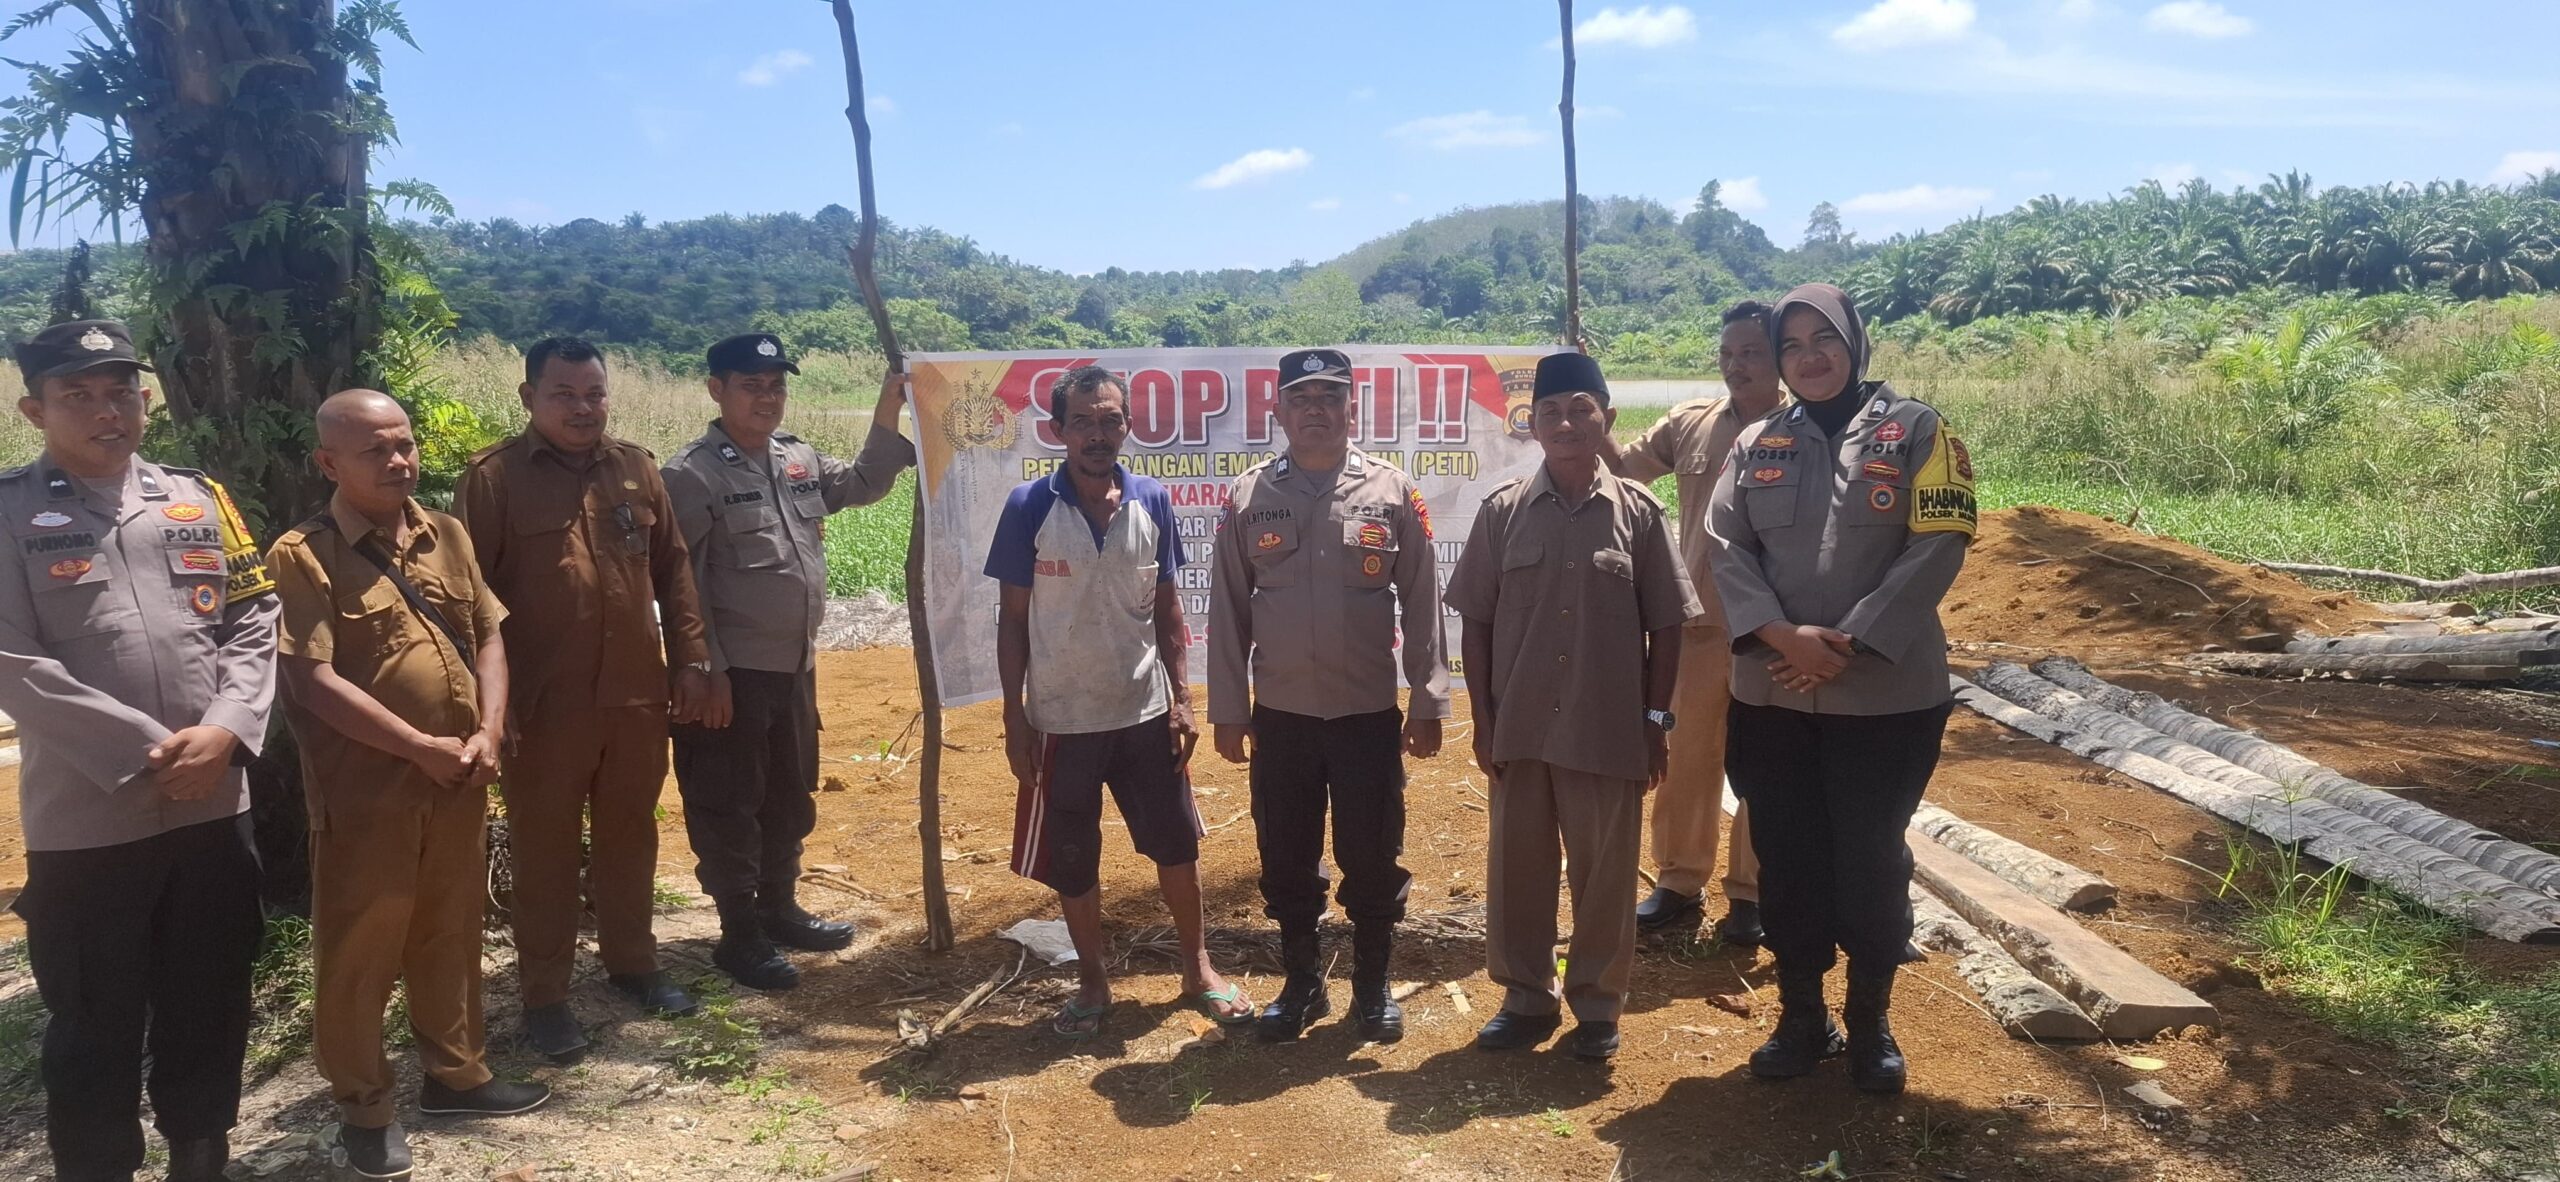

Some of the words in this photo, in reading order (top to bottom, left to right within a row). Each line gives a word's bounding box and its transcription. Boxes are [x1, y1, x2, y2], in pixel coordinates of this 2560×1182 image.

[1030, 367, 1231, 449] SOP
[1415, 364, 1470, 443] !!
[1411, 451, 1478, 480] (PETI)
[1749, 449, 1799, 461] YOSSY
